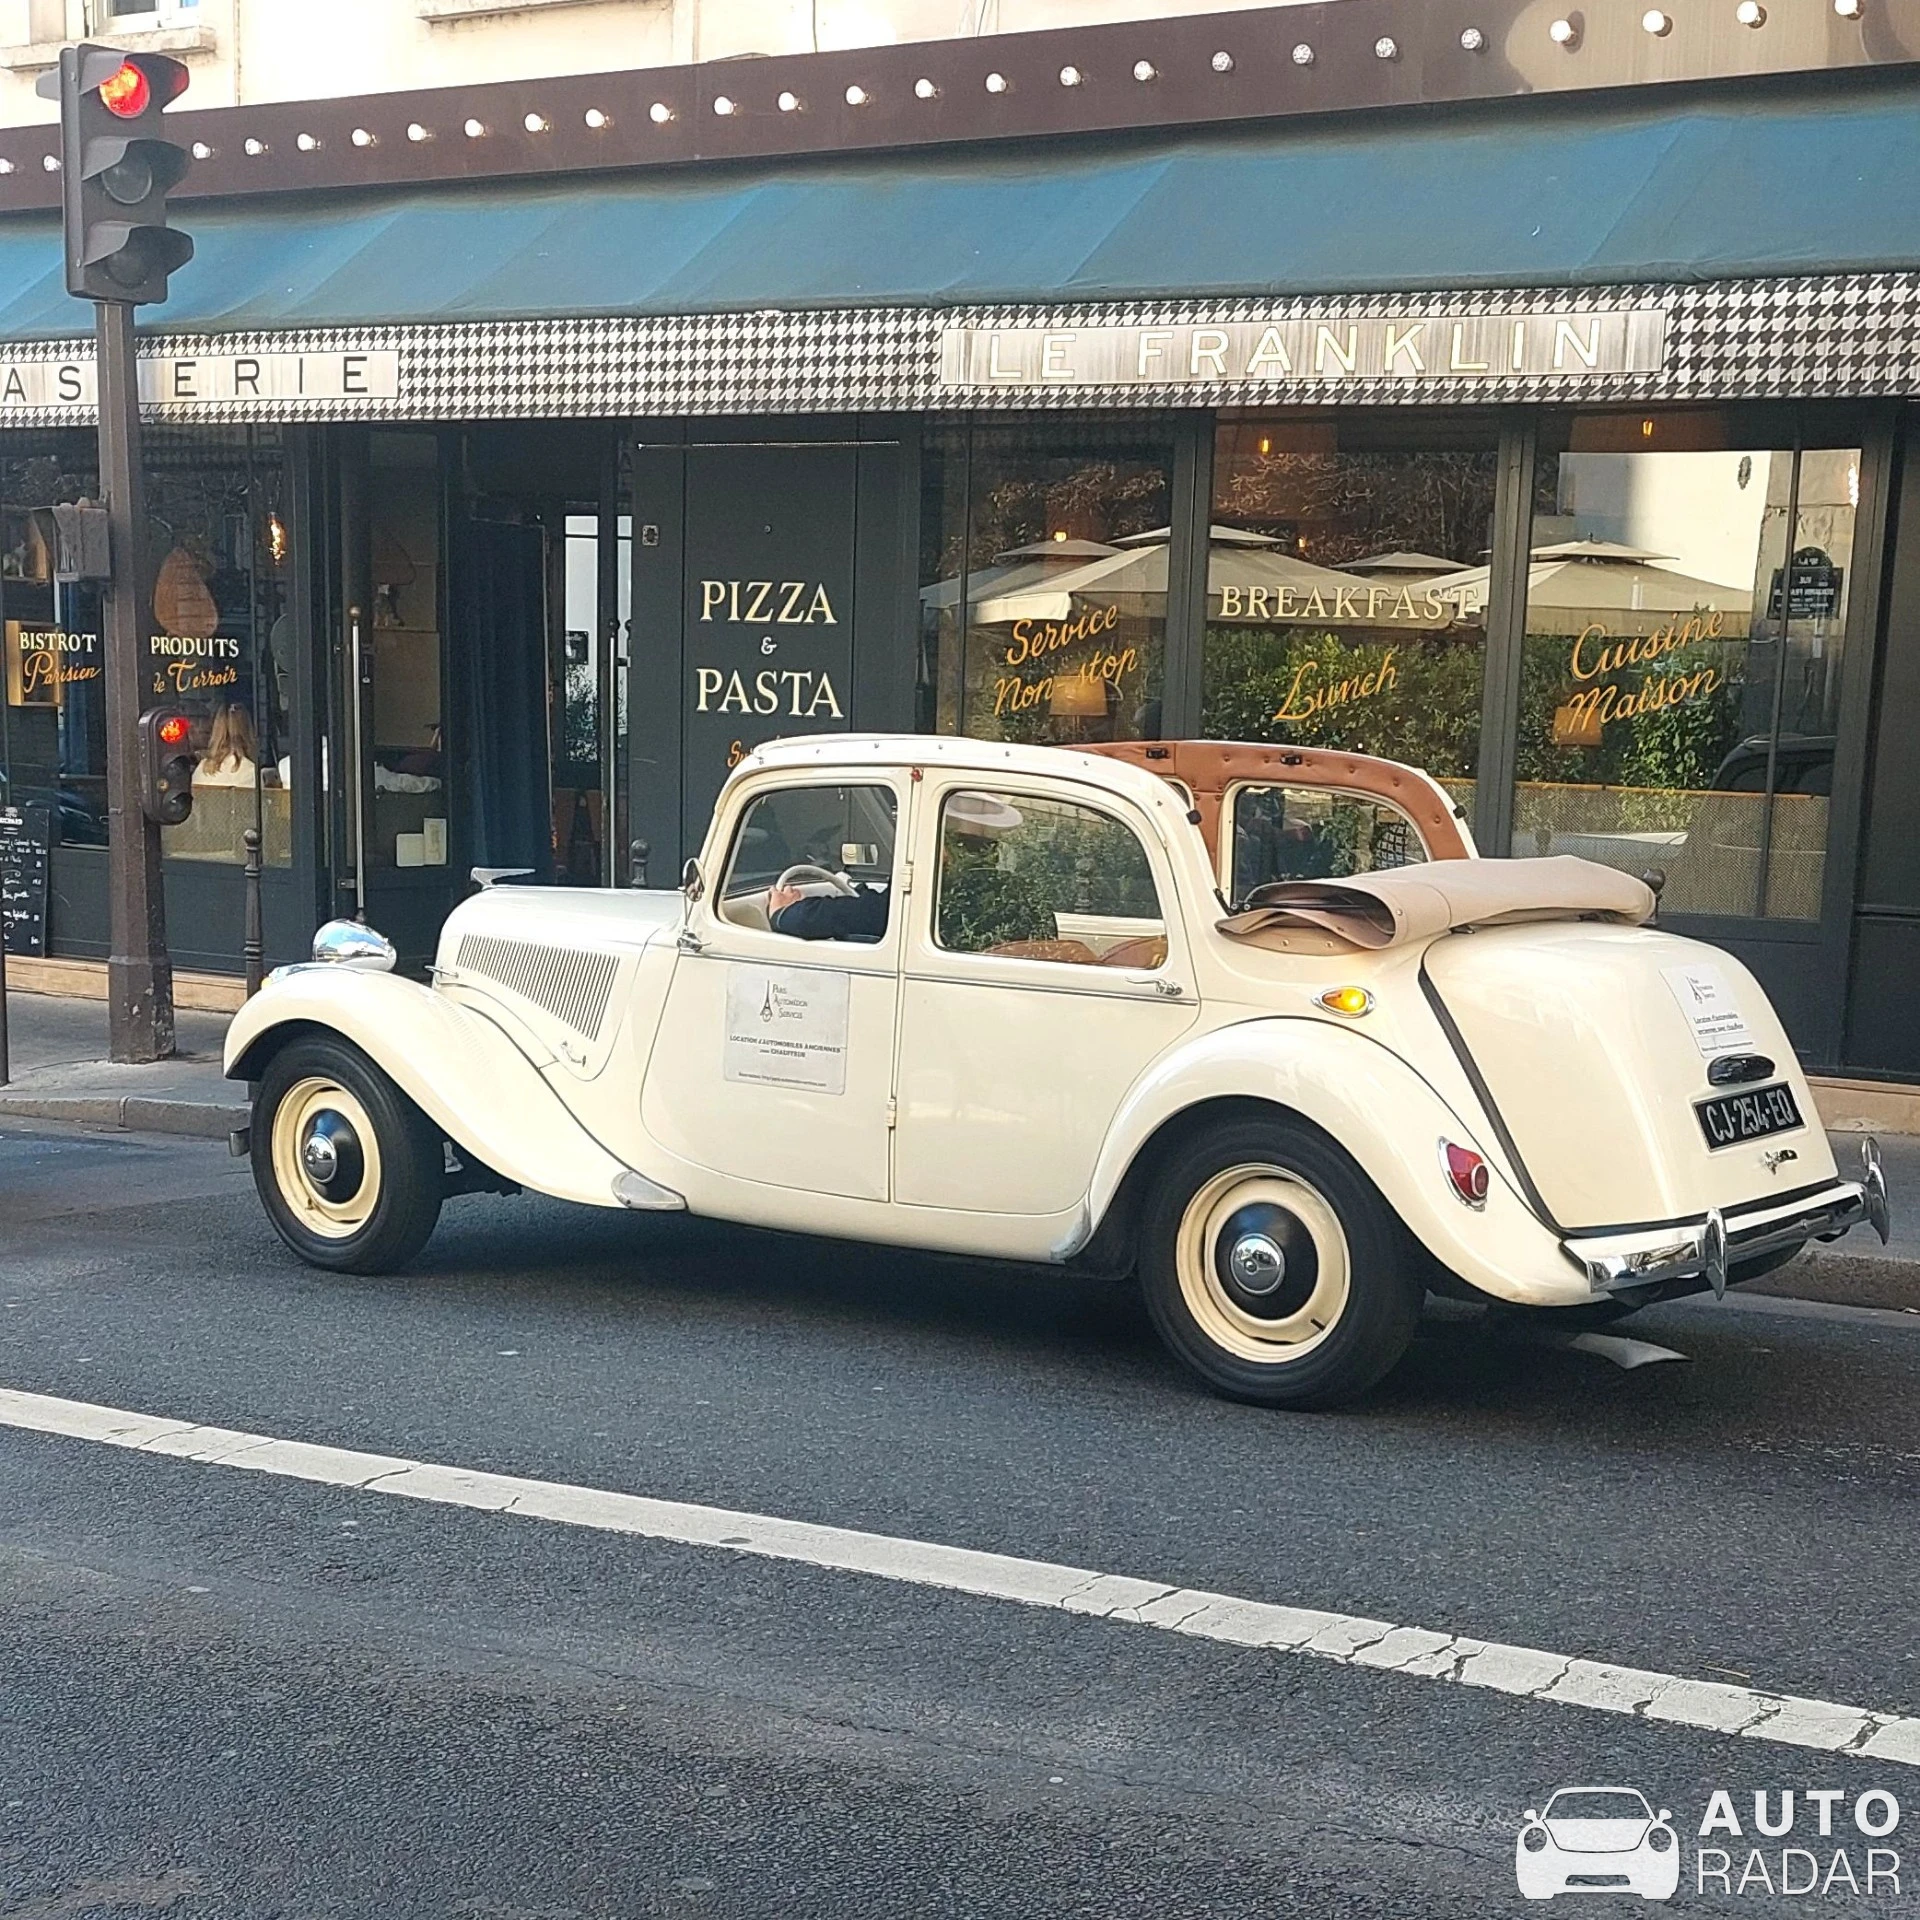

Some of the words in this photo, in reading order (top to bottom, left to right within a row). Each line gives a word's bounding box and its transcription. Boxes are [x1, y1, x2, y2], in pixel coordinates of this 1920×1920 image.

[988, 333, 1076, 379] LE
[1136, 318, 1602, 376] FRANKLIN
[2, 356, 369, 402] ASERIE
[700, 580, 838, 625] PIZZA
[1219, 585, 1482, 620] BREAKFAST
[19, 632, 97, 653] BISTROT
[150, 636, 240, 658] PRODUITS
[760, 636, 777, 655] &
[1007, 604, 1117, 666] Service
[1571, 610, 1724, 681] Cuisine
[23, 651, 102, 694] Parisien
[167, 658, 238, 692] Terroir
[696, 668, 844, 719] PASTA
[1272, 645, 1400, 720] Lunch
[1568, 667, 1724, 735] Maison
[729, 1035, 758, 1044] LOCATION
